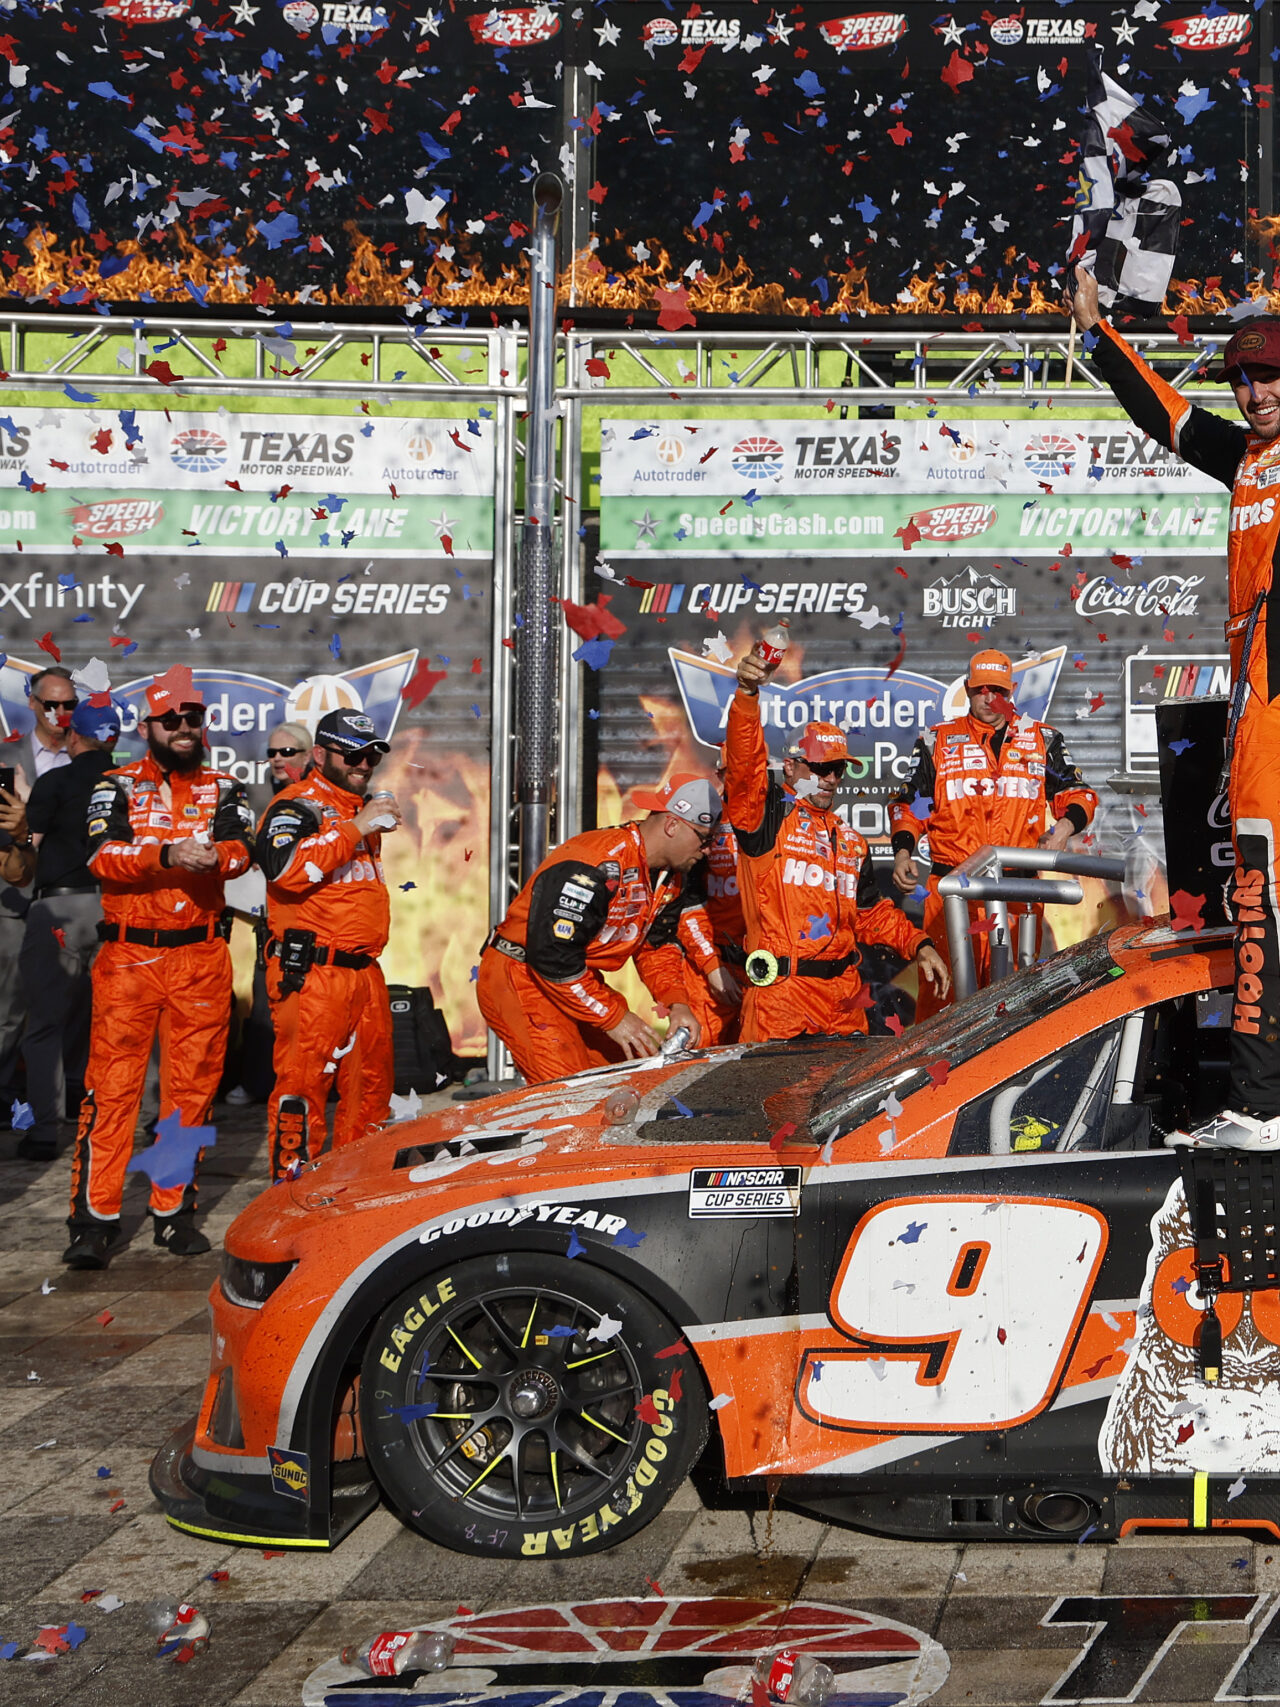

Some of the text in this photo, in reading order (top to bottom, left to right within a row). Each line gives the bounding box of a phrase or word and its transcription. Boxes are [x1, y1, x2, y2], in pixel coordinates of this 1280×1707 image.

[681, 19, 740, 37] TEXAS
[842, 14, 906, 34] SPEEDY
[1026, 19, 1085, 37] TEXAS
[1185, 14, 1251, 34] SPEEDY
[1053, 36, 1084, 44] SPEEDWAY
[240, 432, 354, 468] TEXAS
[794, 436, 902, 466] TEXAS
[1087, 435, 1172, 466] TEXA
[58, 462, 143, 481] utotrader
[239, 468, 351, 482] MOTOR SPEEDWAY
[382, 467, 459, 482] Autotrader
[633, 468, 707, 482] Autotrader
[793, 468, 898, 480] MOTOR SPEEDWAY
[926, 466, 986, 481] Autotrad
[90, 500, 161, 523] SPEEDY
[188, 505, 410, 538] VICTORY LANE
[930, 504, 996, 525] SPEEDY
[679, 512, 884, 540] SpeedyCash.com
[1018, 507, 1222, 537] VICTORY LANE
[0, 572, 146, 619] xfinity
[259, 582, 451, 615] CUP SERIES
[686, 583, 868, 613] CUP SERIES
[922, 587, 1017, 619] BUSCH
[1075, 575, 1206, 618] Coca-Cola
[941, 613, 996, 629] LIGHT
[718, 690, 934, 730] totrader
[946, 776, 1042, 803] HOOTERS
[675, 800, 693, 814] 9
[787, 833, 814, 848] UniFirst
[556, 922, 573, 936] NAPA
[724, 1170, 785, 1187] NASCAR
[704, 1191, 785, 1208] CUP SERIES
[798, 1193, 1110, 1436] 9
[380, 1276, 458, 1374] EAGLE
